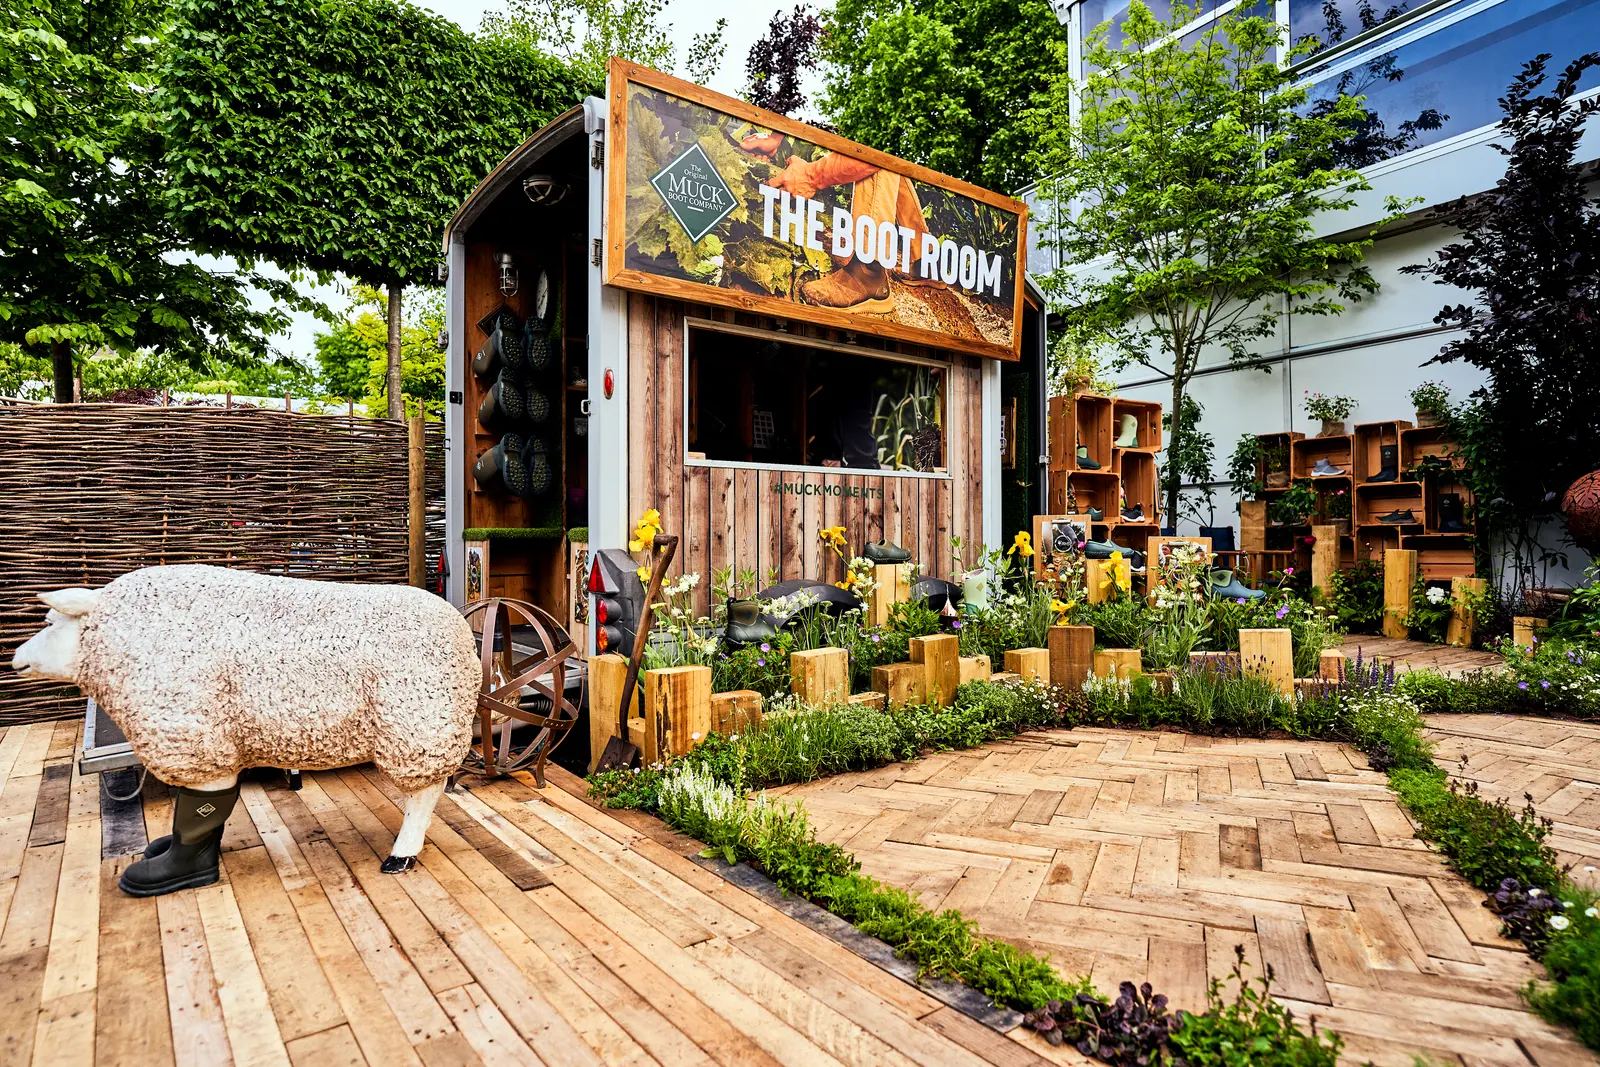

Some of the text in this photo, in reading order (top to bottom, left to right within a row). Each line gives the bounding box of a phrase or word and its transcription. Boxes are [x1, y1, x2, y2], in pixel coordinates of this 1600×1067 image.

[684, 169, 708, 180] Original
[690, 164, 702, 173] The
[668, 192, 724, 212] BOOT COMPANY
[759, 183, 1002, 298] THE BOOT ROOM
[774, 482, 884, 499] #MUCKMOMENTS
